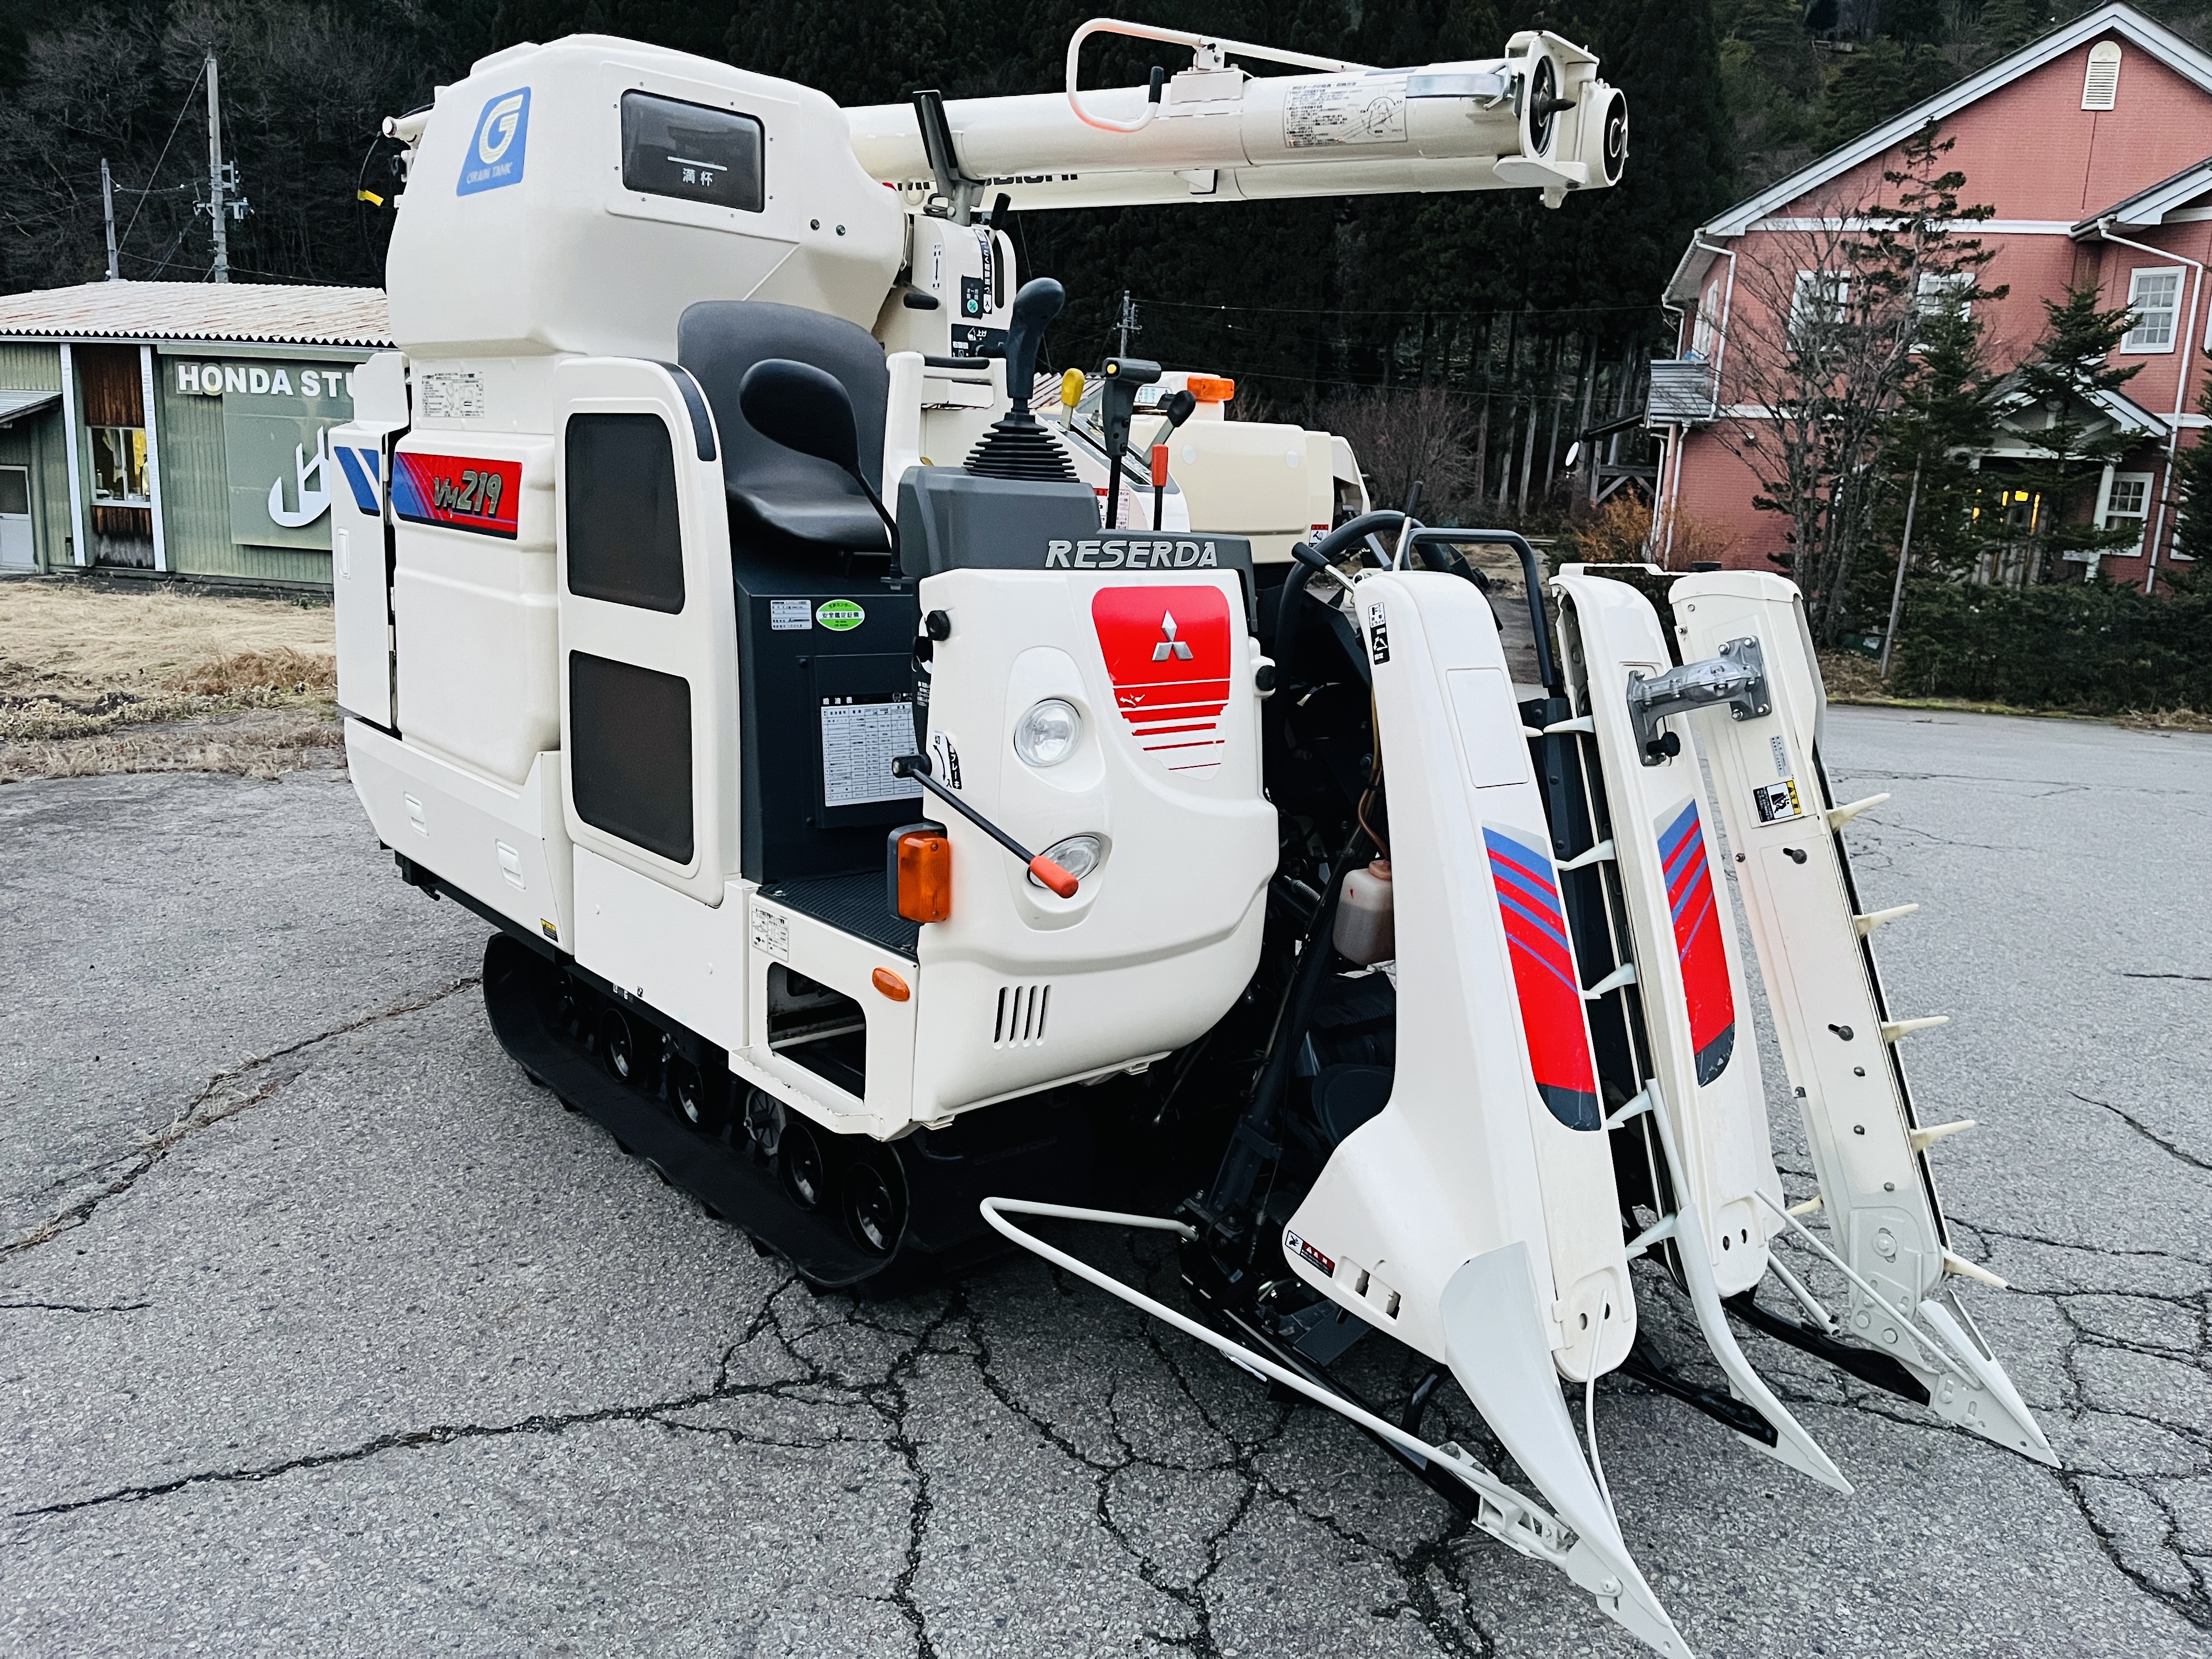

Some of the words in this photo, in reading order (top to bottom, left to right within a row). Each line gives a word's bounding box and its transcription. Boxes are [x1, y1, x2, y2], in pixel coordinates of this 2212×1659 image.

[492, 162, 514, 177] TANK
[682, 167, 713, 187] 満杯
[178, 365, 294, 396] HONDA
[1045, 540, 1218, 568] RESERDA
